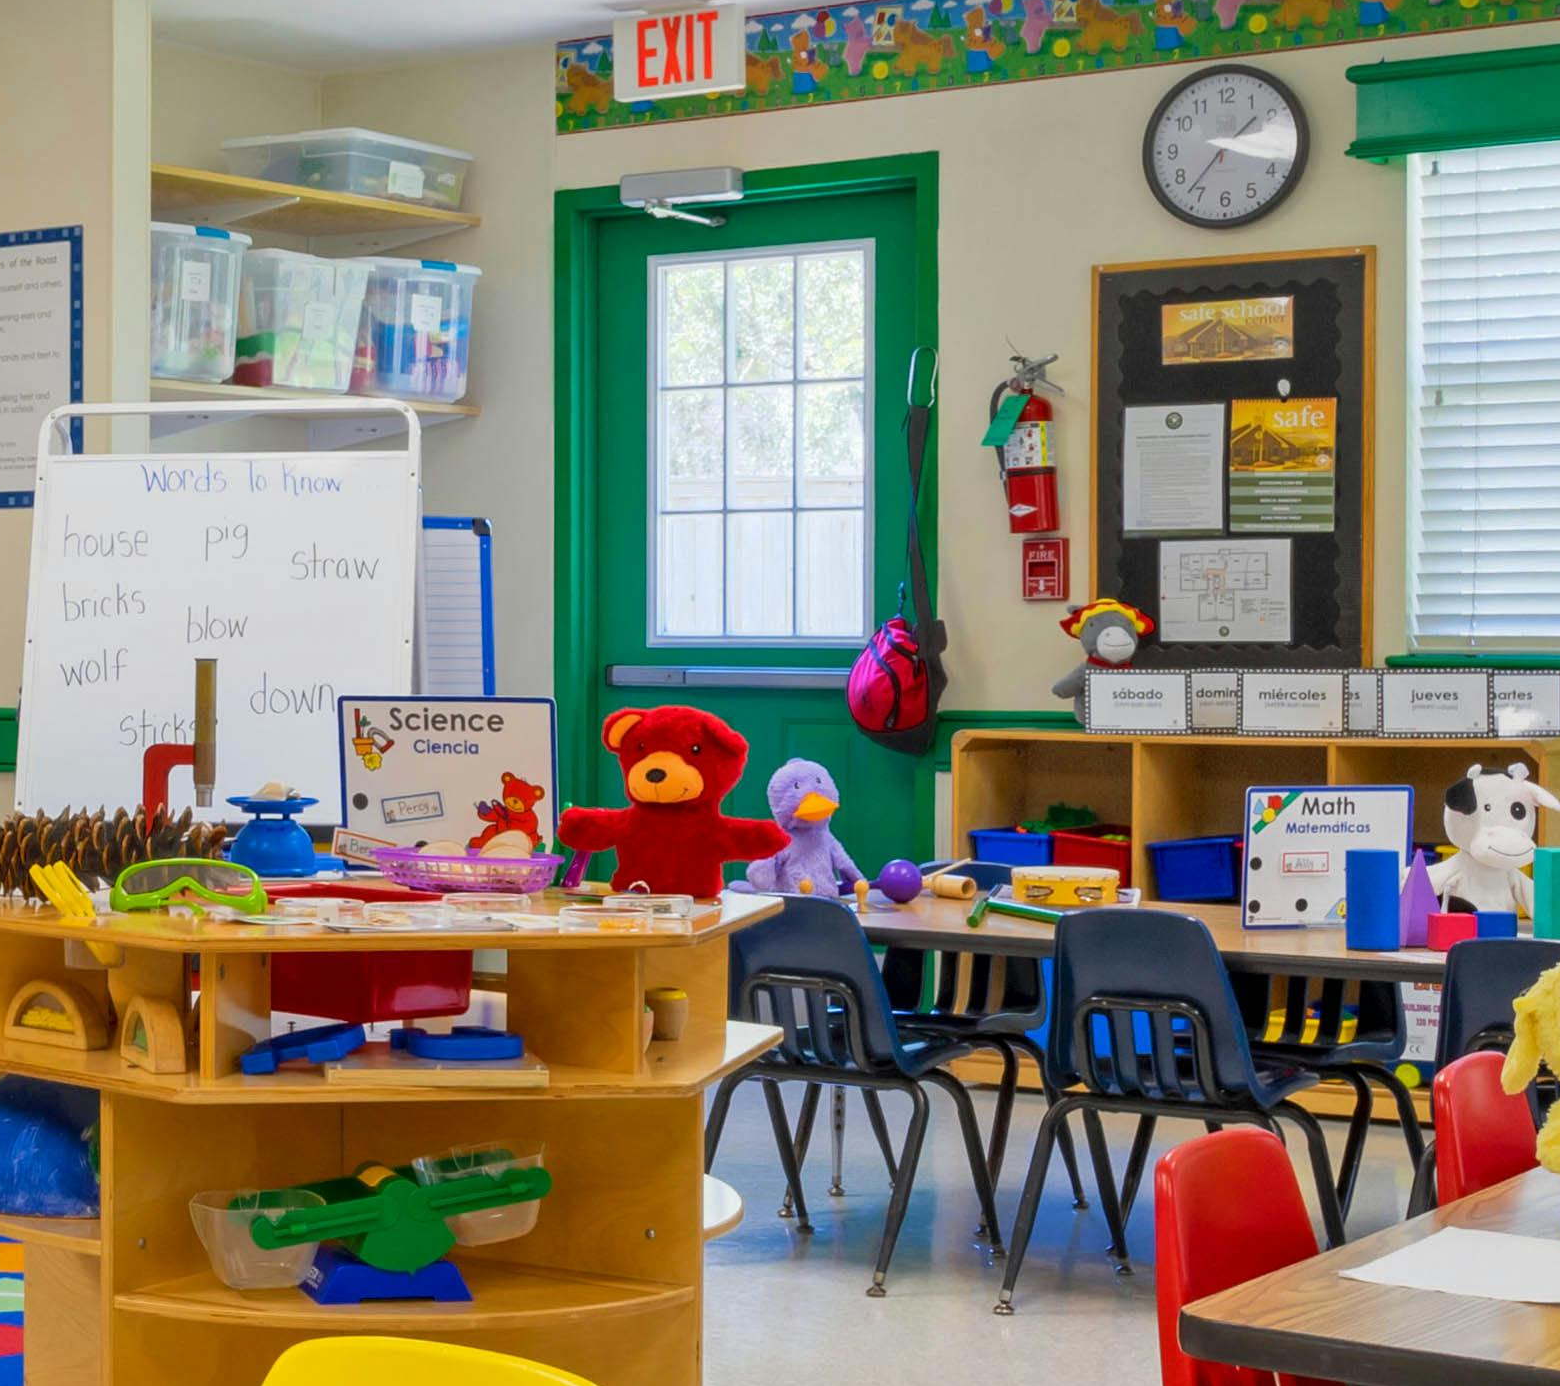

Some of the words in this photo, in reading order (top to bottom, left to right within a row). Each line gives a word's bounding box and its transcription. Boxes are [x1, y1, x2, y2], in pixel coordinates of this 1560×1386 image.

[635, 10, 718, 88] EXIT
[1218, 88, 1235, 104] 12
[1192, 99, 1207, 114] 11
[1175, 116, 1193, 132] 10
[1168, 144, 1178, 160] 9
[1175, 169, 1186, 184] 8
[1266, 163, 1276, 178] 4
[1195, 187, 1206, 202] 7
[1246, 183, 1256, 198] 5
[1220, 191, 1231, 207] 6
[1180, 303, 1216, 321] safe
[1221, 300, 1286, 319] school
[1274, 405, 1325, 429] safe
[140, 464, 227, 494] Words
[248, 464, 267, 492] To
[65, 515, 151, 557] house
[204, 516, 249, 562] pig
[289, 541, 379, 580] straw
[1029, 550, 1055, 559] FIRE
[61, 582, 146, 623] bricks
[186, 605, 248, 644] blow
[60, 648, 128, 687] wolf
[249, 671, 336, 714] down
[1112, 687, 1163, 700] sábado
[1259, 686, 1327, 701] miércoles
[1412, 690, 1458, 702] jueves
[389, 707, 504, 732] Science
[413, 740, 479, 754] Ciencia
[1302, 797, 1355, 815] Math
[1286, 821, 1370, 834] Matemáticas
